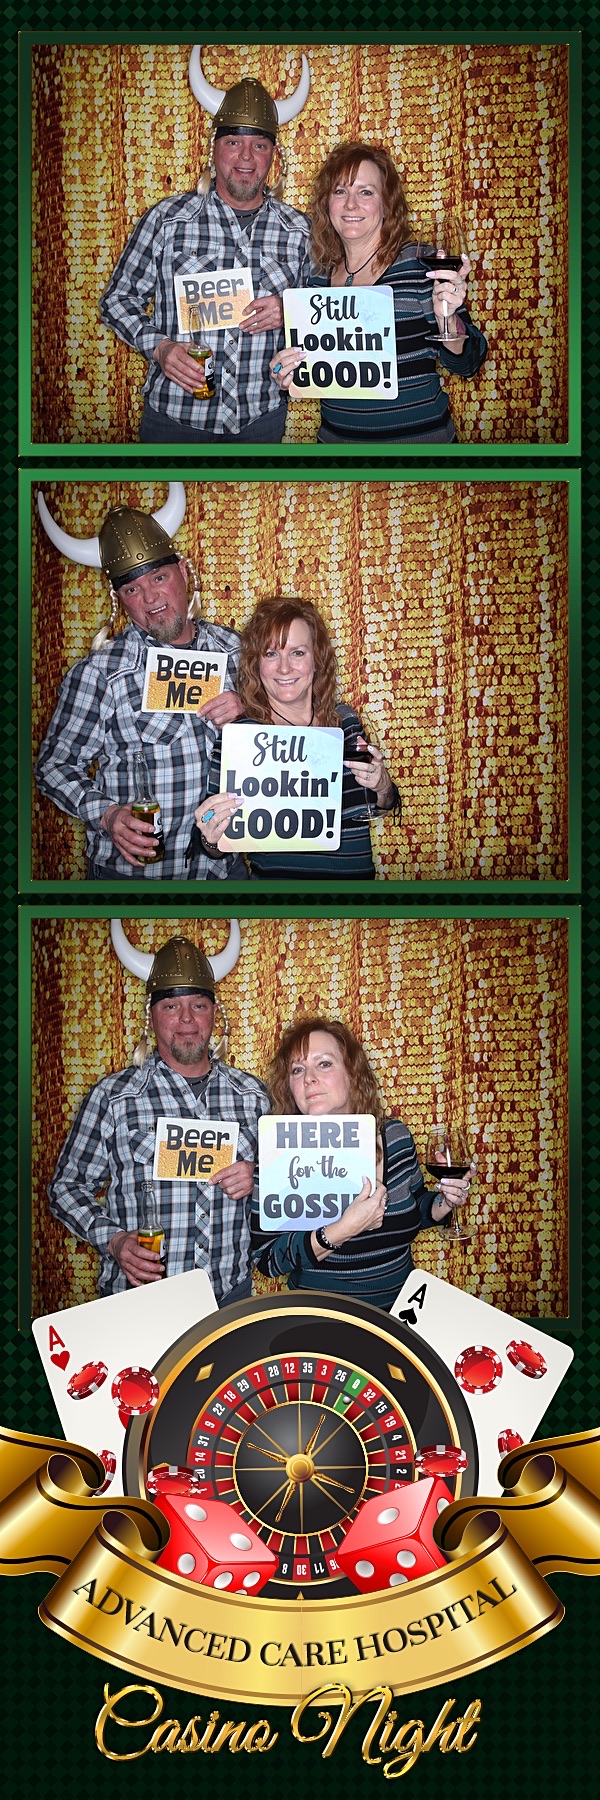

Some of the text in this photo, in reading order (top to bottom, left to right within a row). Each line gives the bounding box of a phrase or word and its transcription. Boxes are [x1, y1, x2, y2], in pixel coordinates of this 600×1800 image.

[182, 278, 244, 304] Beer
[199, 301, 234, 326] Me
[310, 294, 360, 325] Still
[290, 327, 390, 352] Lookin'
[293, 361, 391, 389] GOOD!
[156, 654, 218, 682] Beer
[165, 681, 202, 708] Me
[252, 731, 307, 767] Still
[226, 770, 338, 798] Lookin'
[224, 808, 336, 839] GOOD!
[166, 1124, 230, 1151] Beer
[276, 1121, 360, 1149] HERE
[176, 1150, 214, 1177] Me
[287, 1155, 348, 1190] for the
[263, 1193, 360, 1219] GOSSI
